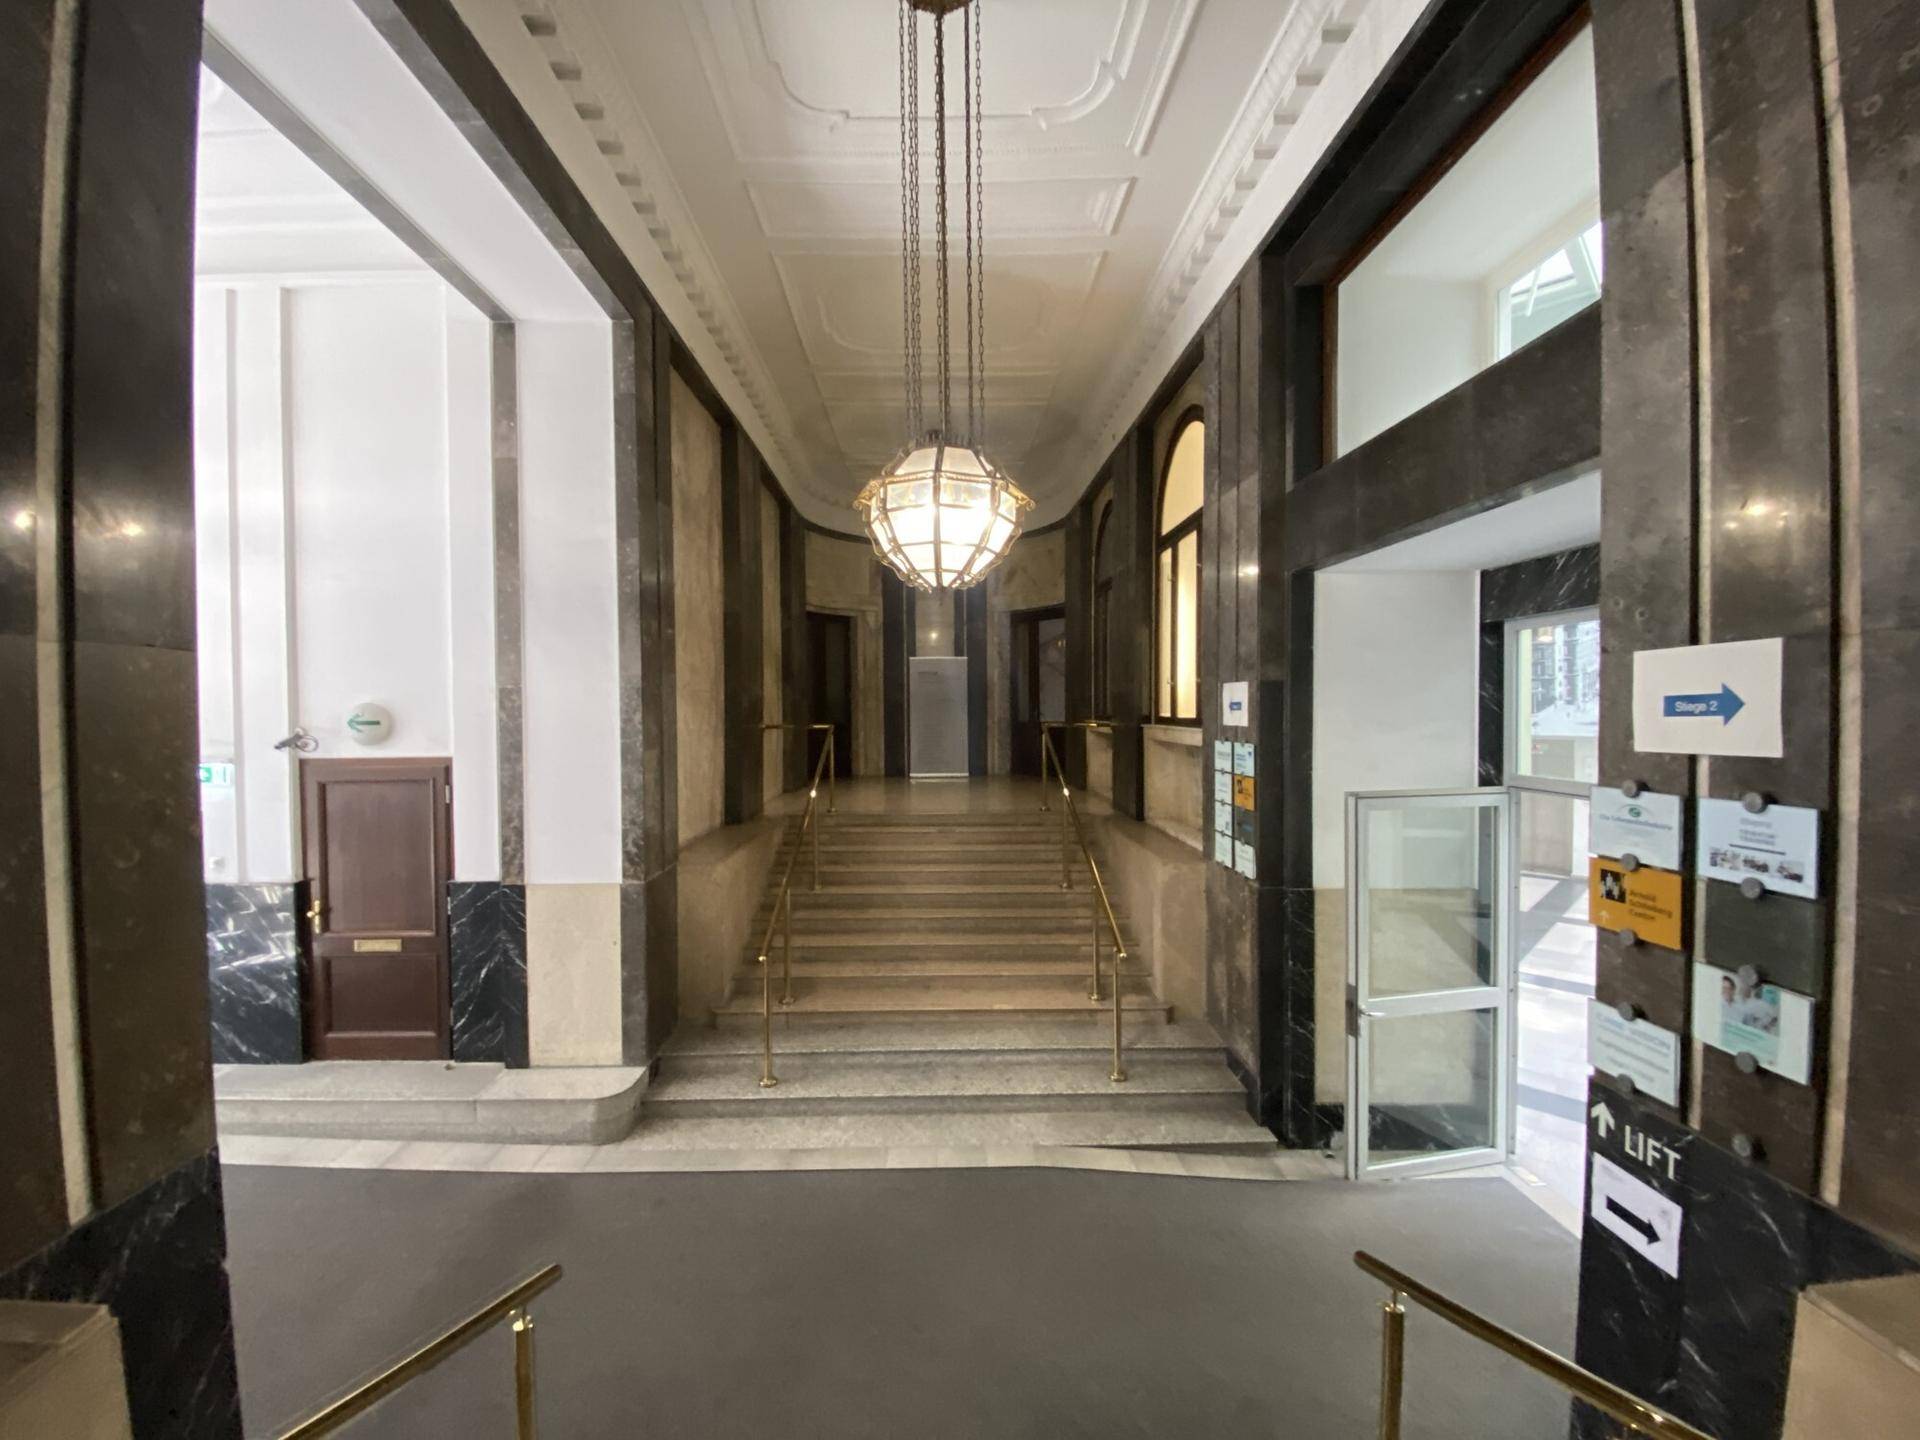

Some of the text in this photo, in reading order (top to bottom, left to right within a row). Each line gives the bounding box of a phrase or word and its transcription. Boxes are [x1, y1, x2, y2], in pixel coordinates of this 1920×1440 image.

[1674, 700, 1718, 714] Stiege 2
[1624, 1124, 1682, 1181] LIFT
